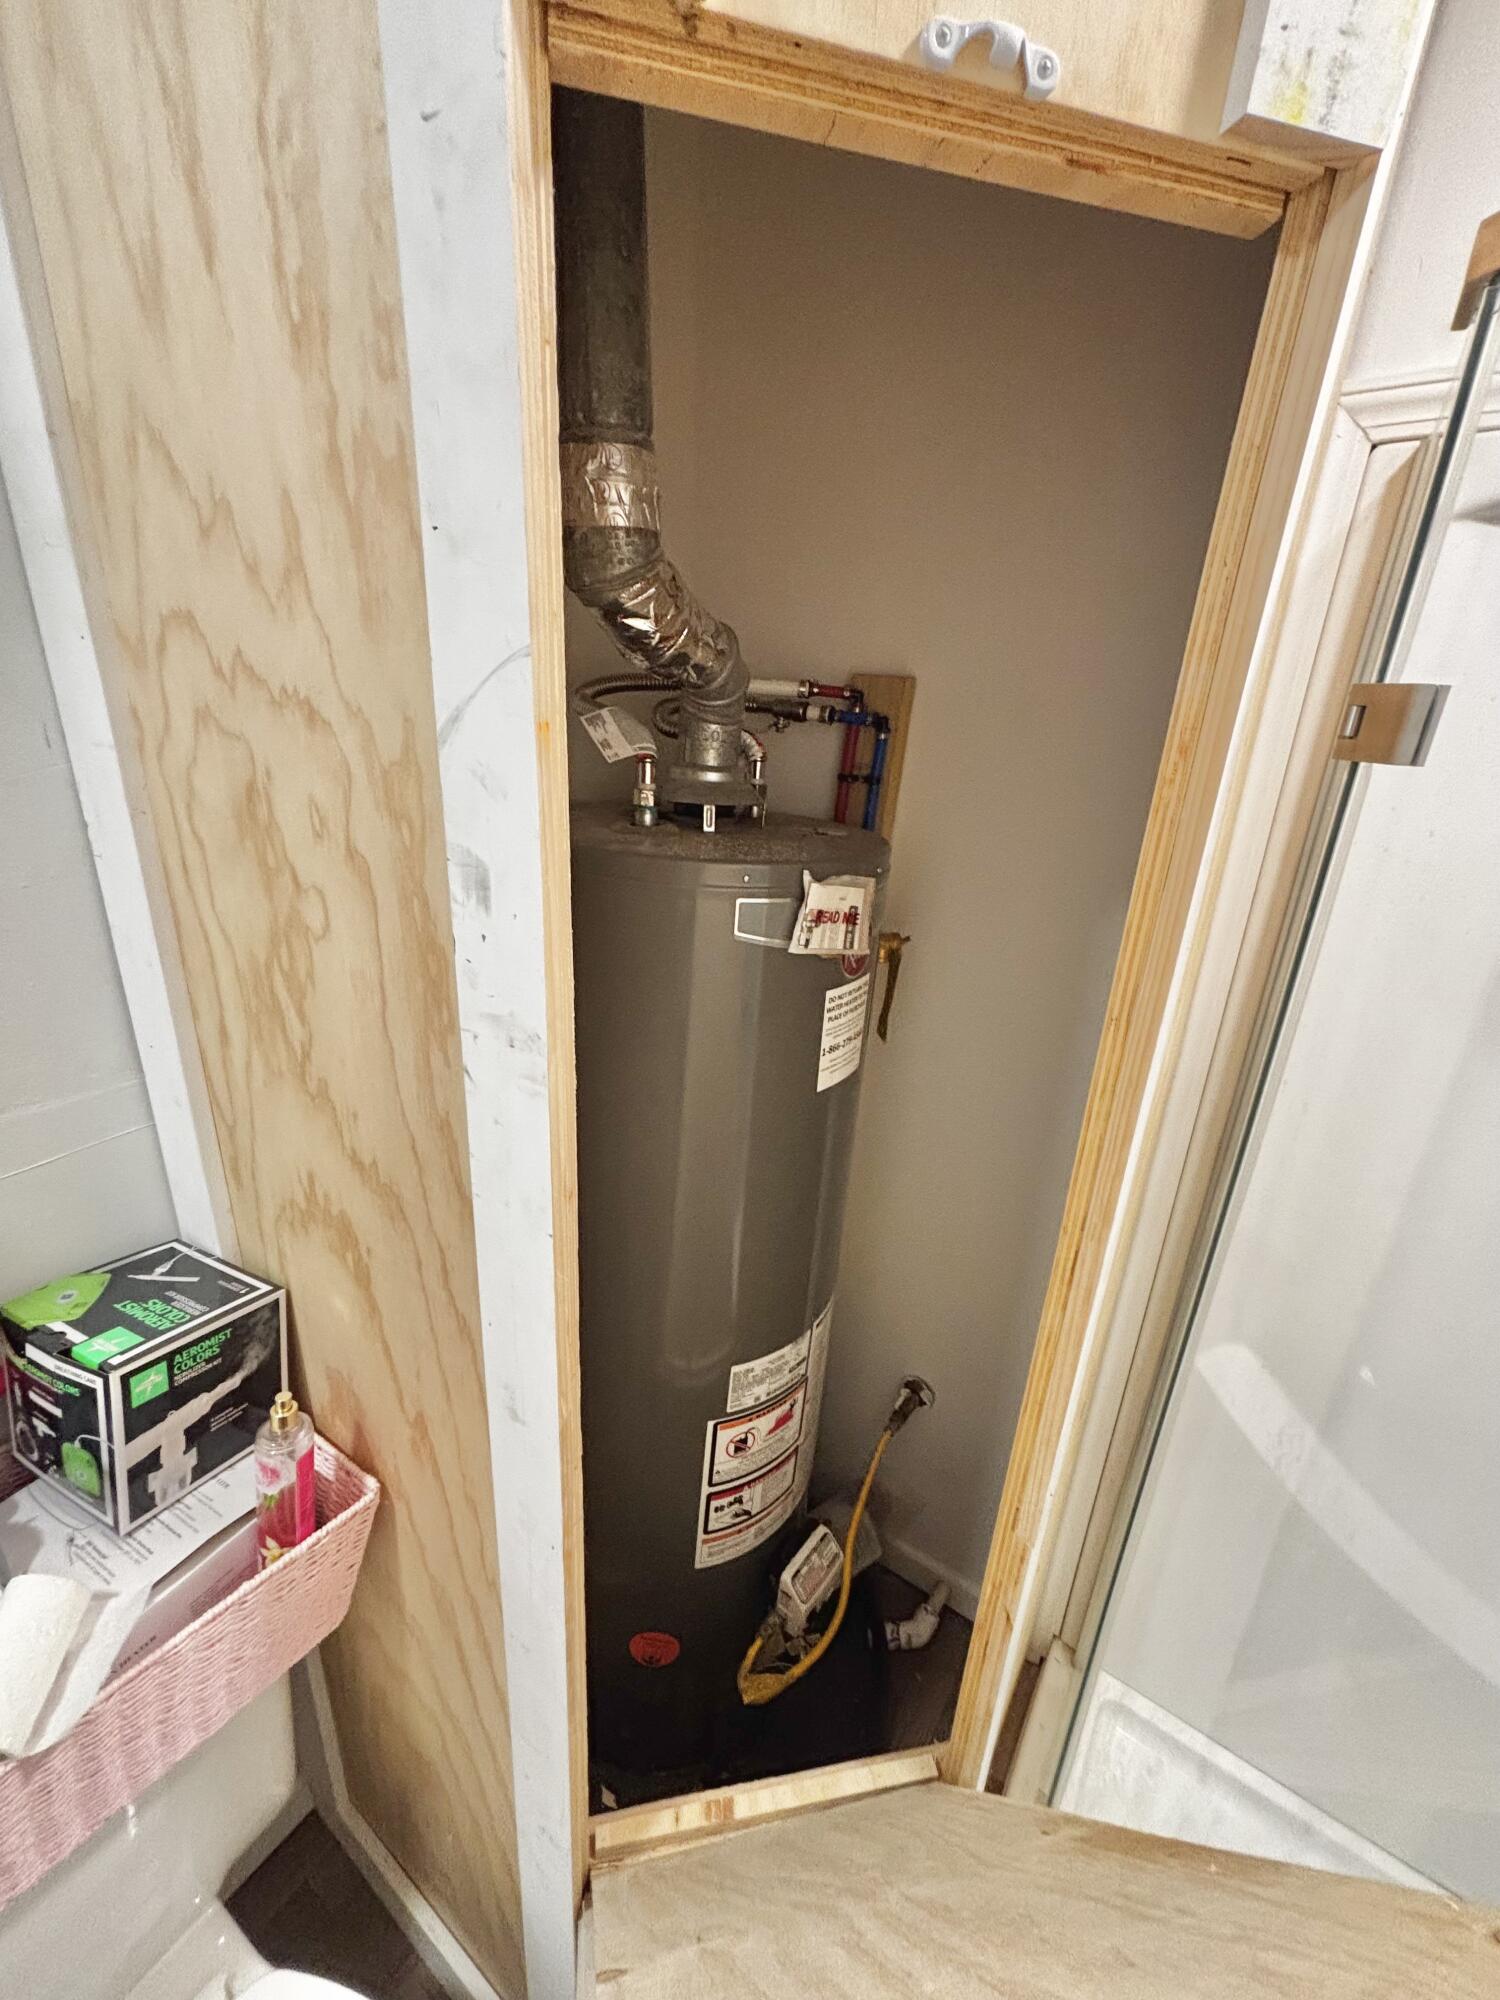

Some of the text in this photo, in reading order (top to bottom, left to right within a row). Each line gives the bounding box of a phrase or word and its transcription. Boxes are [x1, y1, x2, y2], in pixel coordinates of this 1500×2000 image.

[815, 909, 840, 926] READ
[112, 1300, 176, 1330] AEROMIST
[140, 1299, 191, 1323] COLORS
[173, 1328, 232, 1365] AEROMIST
[173, 1344, 221, 1374] COLORS
